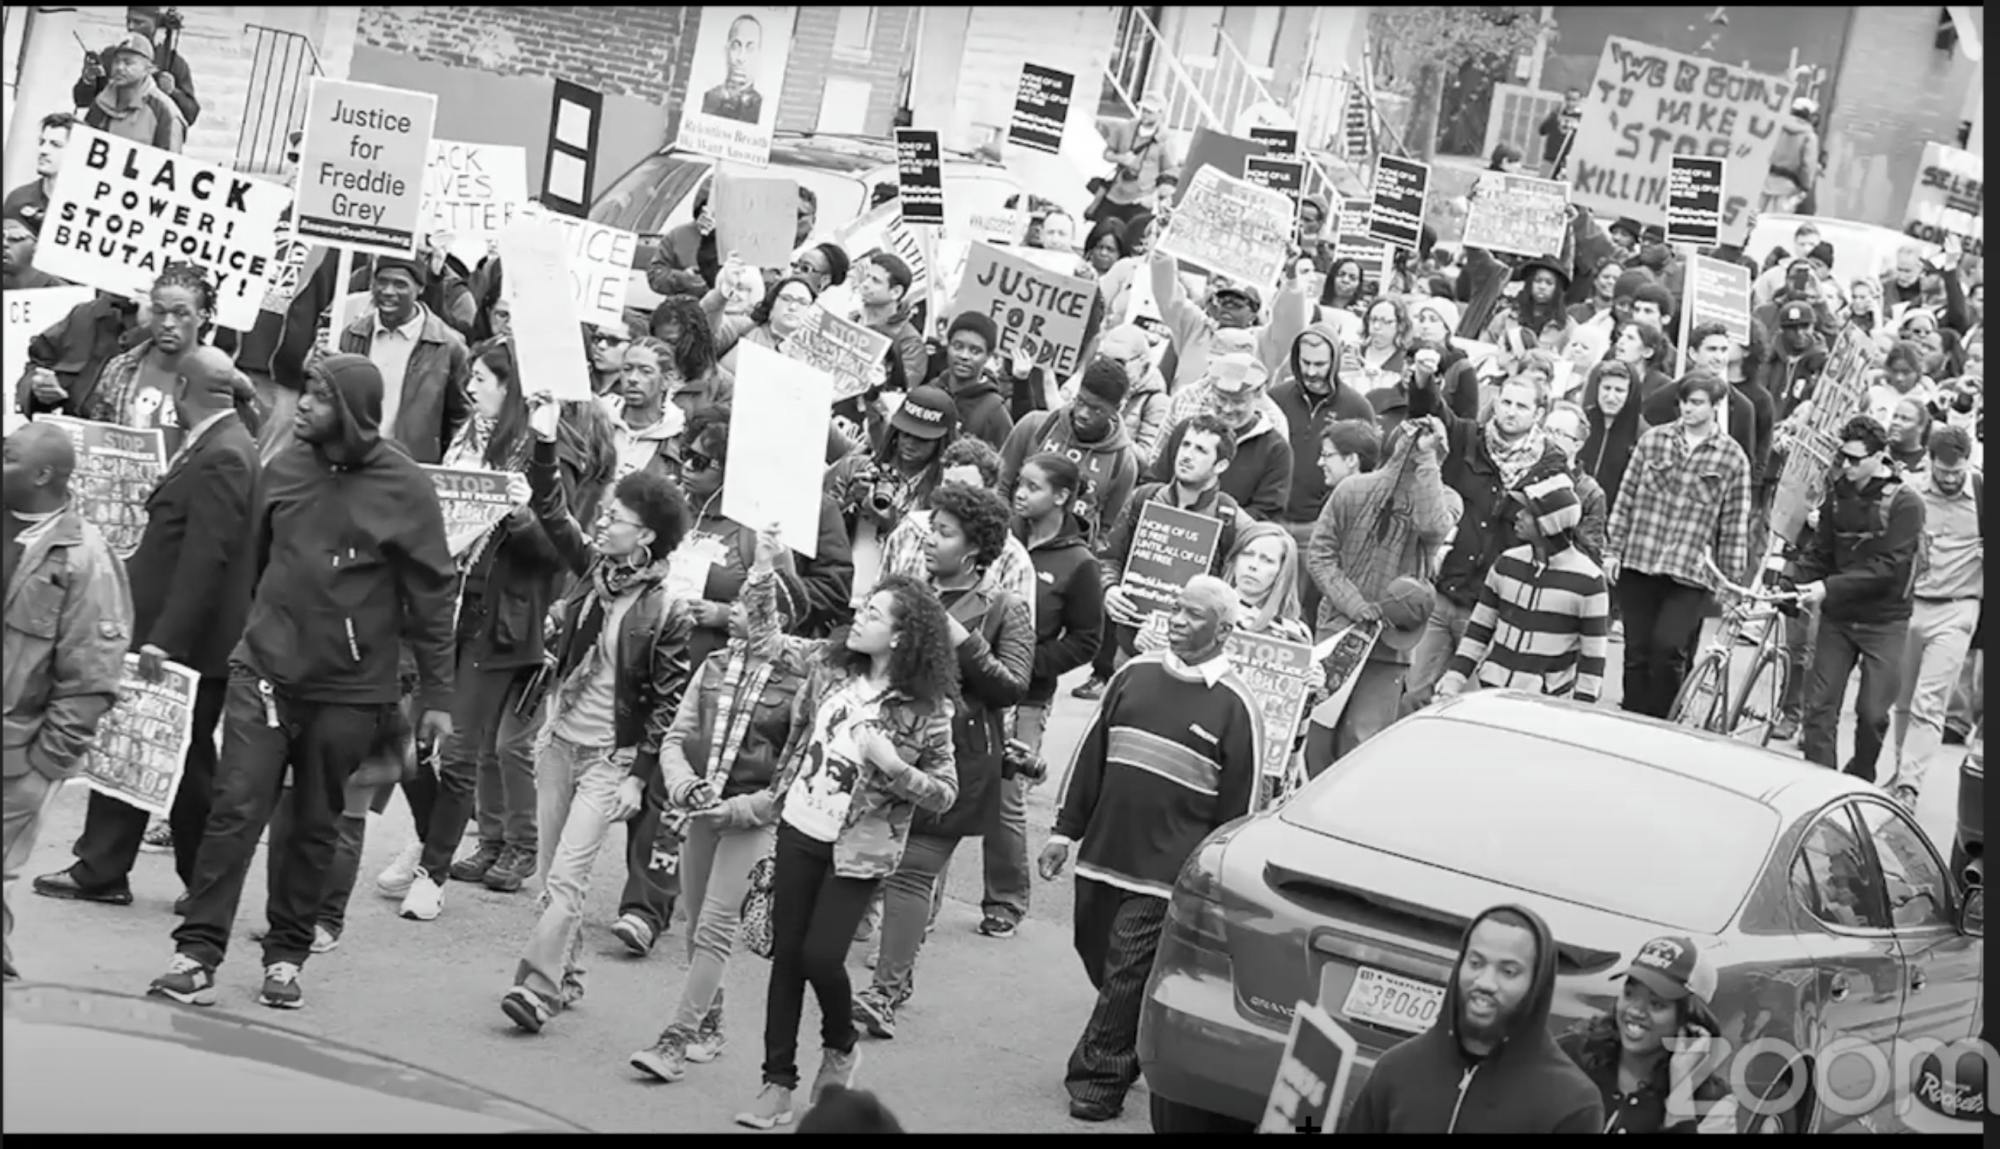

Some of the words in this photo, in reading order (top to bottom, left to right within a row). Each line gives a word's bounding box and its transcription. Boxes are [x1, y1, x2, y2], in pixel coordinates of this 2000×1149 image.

[330, 98, 411, 134] Justice
[1597, 79, 1634, 109] TO
[1656, 97, 1738, 136] MAKE
[1748, 114, 1775, 140] U
[349, 133, 384, 161] for
[428, 145, 483, 172] ACK
[86, 137, 253, 213] BLACK
[319, 162, 406, 197] Freddie
[1574, 158, 1668, 212] KILLIN
[94, 181, 235, 239] POWER!
[331, 192, 386, 225] Grey
[60, 201, 145, 239] STOP
[160, 229, 267, 277] POLICE
[977, 261, 1088, 319] JUSTICE
[990, 299, 1046, 337] FOR
[999, 325, 1076, 371] EDDIE
[430, 472, 496, 494] STOP
[1143, 519, 1171, 534] NONE
[1171, 526, 1185, 537] OF
[1185, 530, 1199, 542] US
[1180, 549, 1194, 561] OF
[1193, 553, 1208, 566] US
[1222, 635, 1295, 662] STOP
